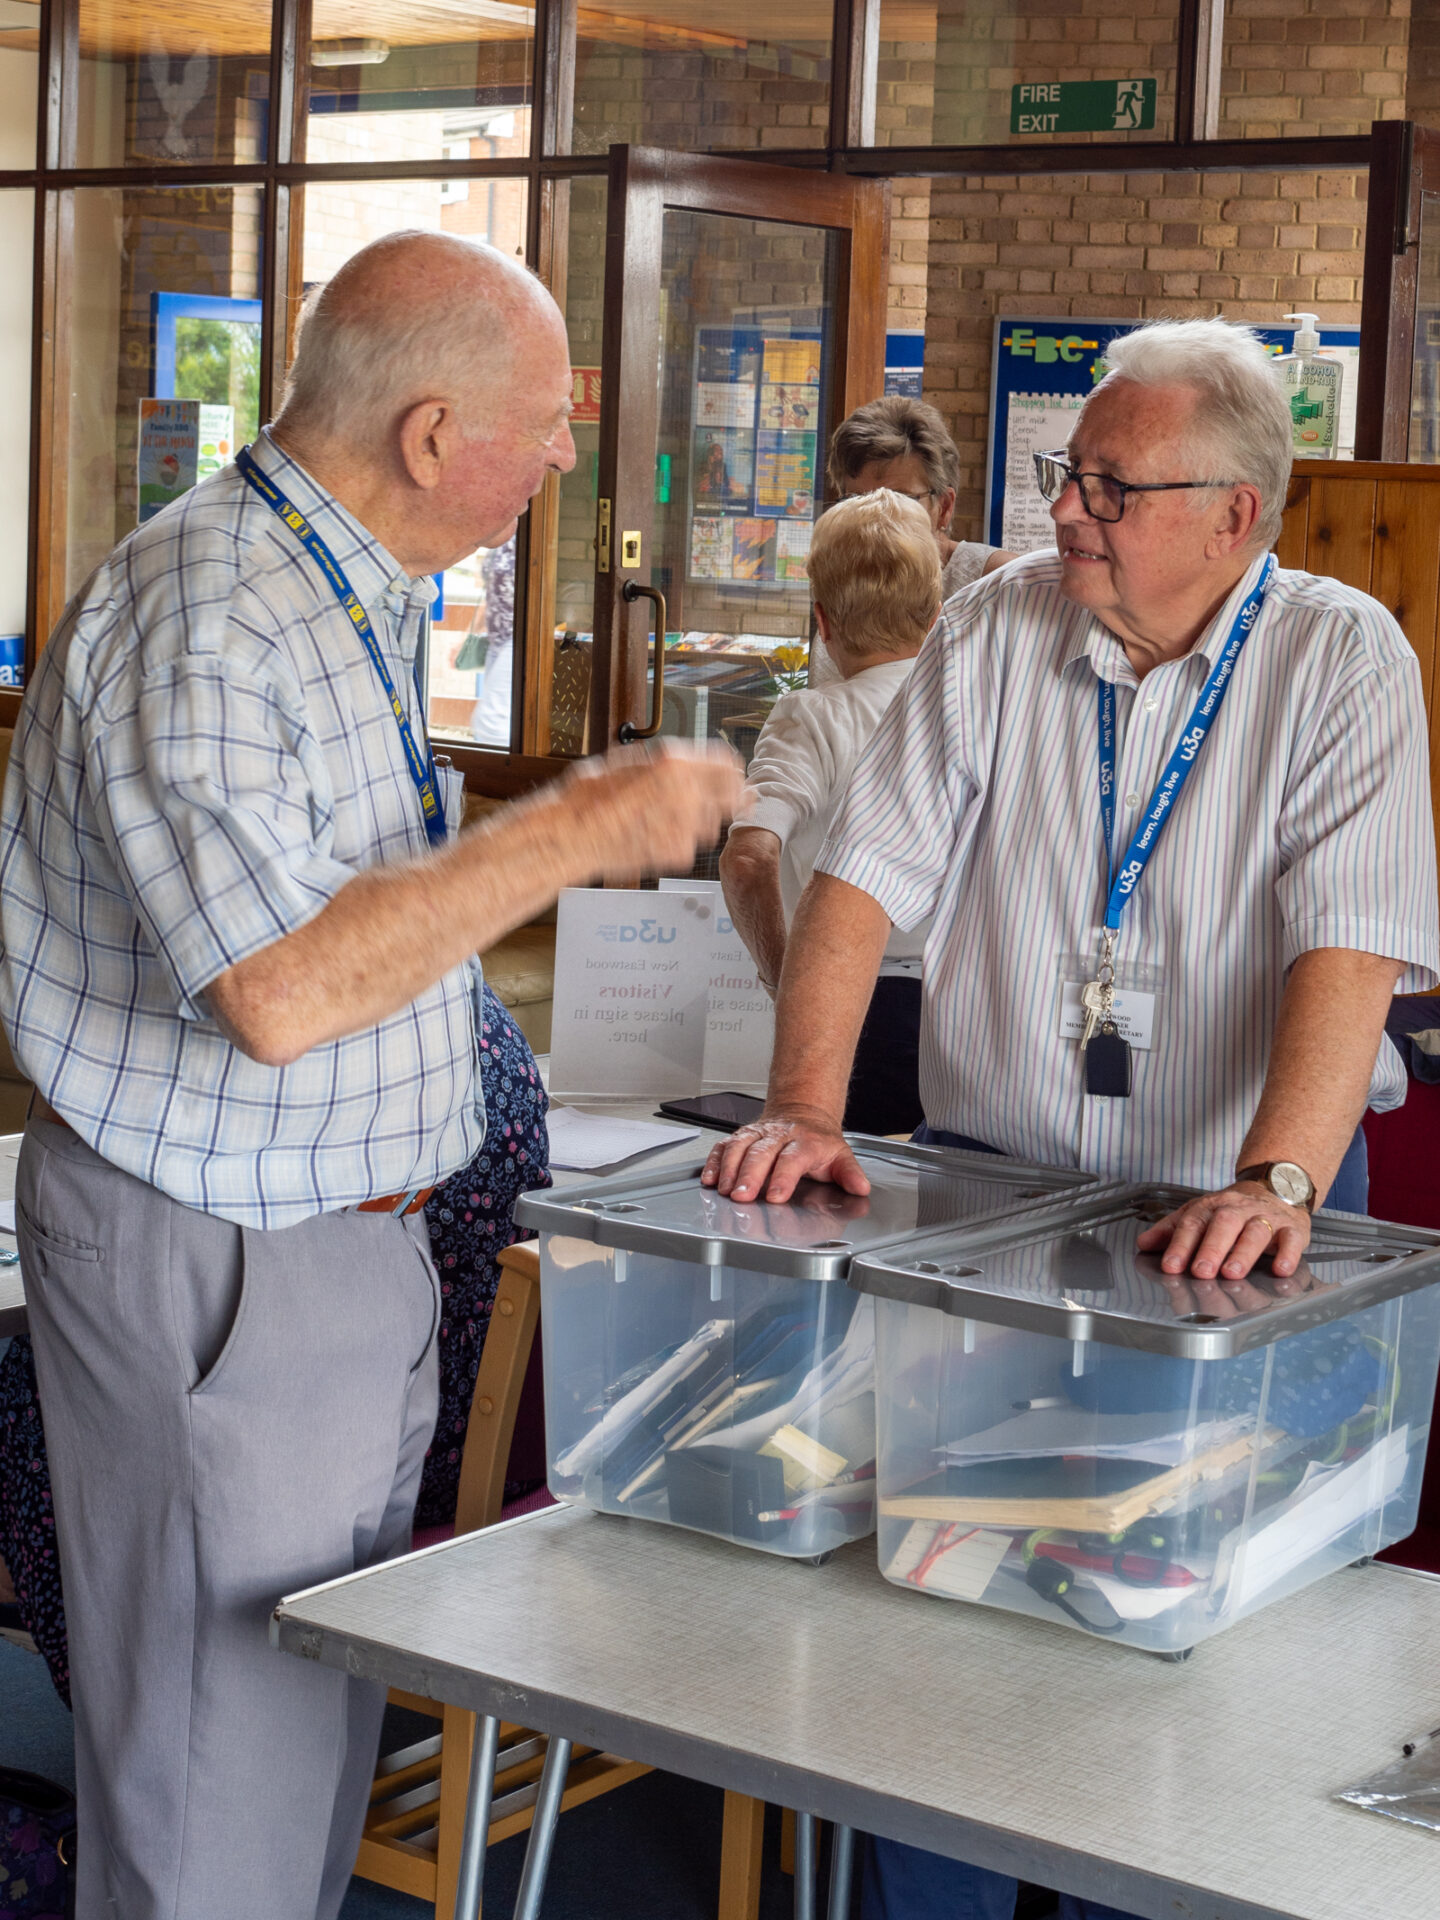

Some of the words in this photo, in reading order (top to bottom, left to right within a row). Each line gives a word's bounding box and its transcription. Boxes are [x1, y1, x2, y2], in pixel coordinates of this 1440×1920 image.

[1020, 84, 1061, 103] FIRE
[1018, 114, 1059, 132] EXIT
[1011, 328, 1084, 363] EBC
[1240, 601, 1259, 630] u3a
[1199, 687, 1221, 716] learn,
[1212, 658, 1234, 689] laugh,
[1226, 640, 1240, 658] live
[1180, 727, 1205, 761] u3a
[1101, 760, 1113, 796] u3a
[1136, 821, 1158, 849] learn,
[1150, 790, 1172, 820] laugh,
[1164, 771, 1180, 790] live
[1118, 860, 1143, 894] u3a
